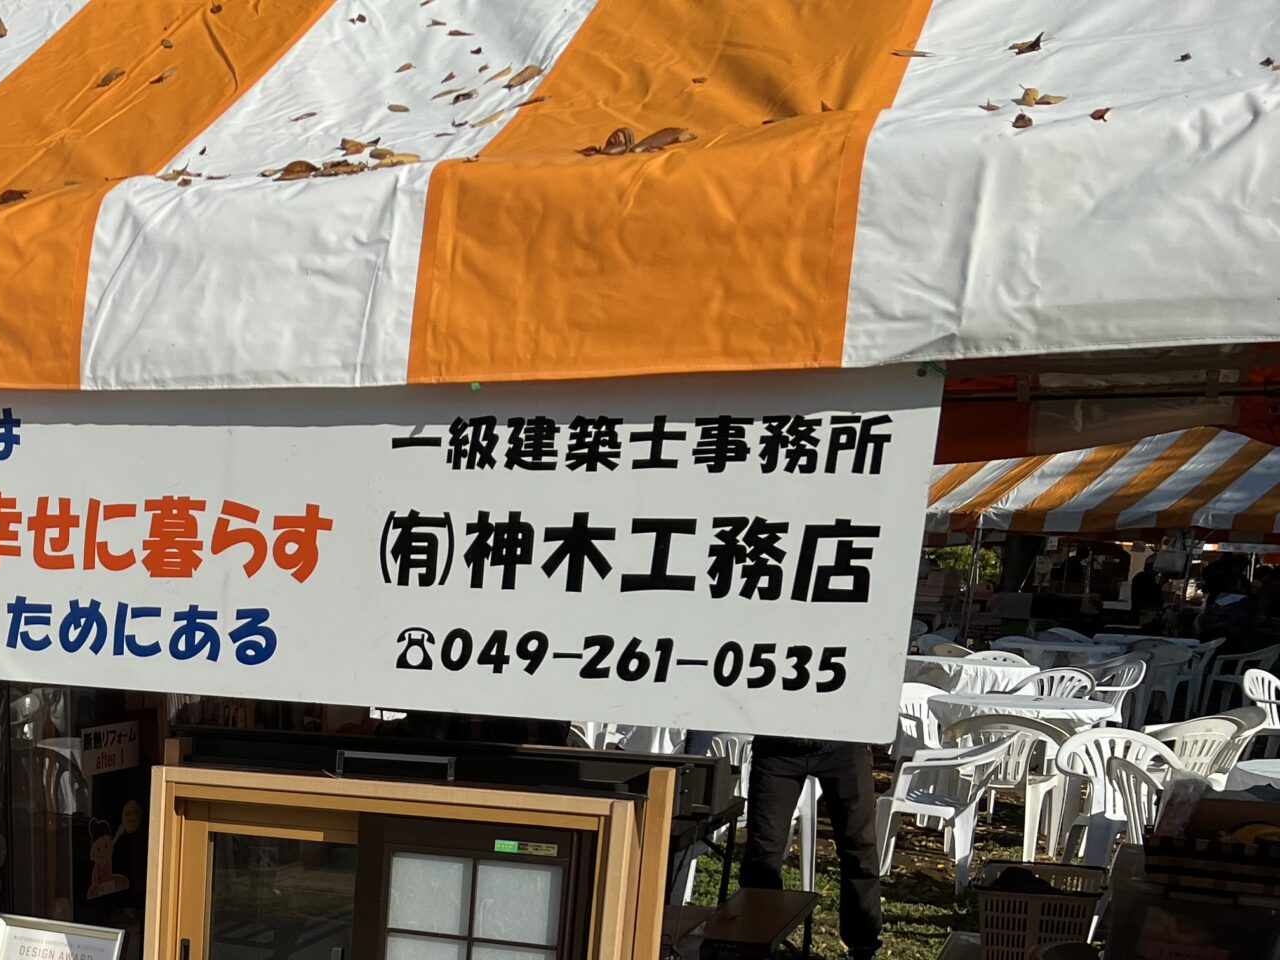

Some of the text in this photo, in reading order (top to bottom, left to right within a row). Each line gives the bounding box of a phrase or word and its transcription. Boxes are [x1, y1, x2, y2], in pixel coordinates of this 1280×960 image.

[391, 414, 893, 476] 一級建築士事務所
[6, 596, 278, 666] ためにある
[96, 753, 116, 769] after
